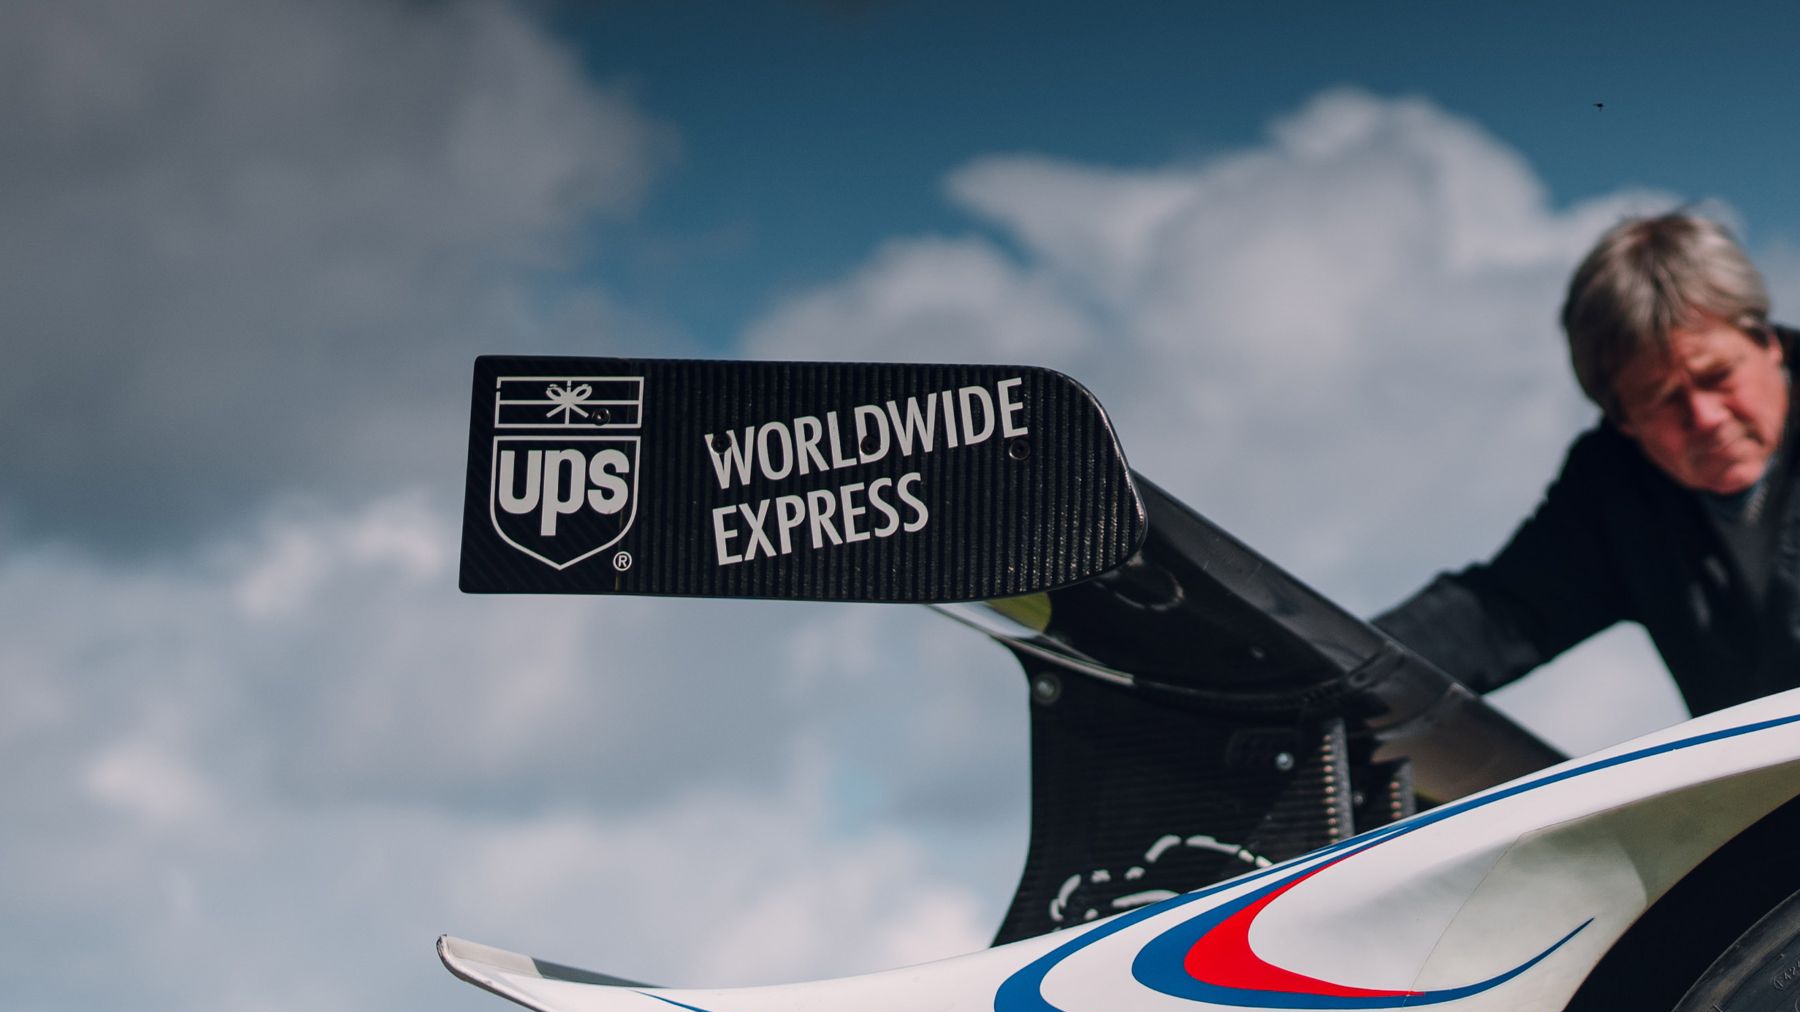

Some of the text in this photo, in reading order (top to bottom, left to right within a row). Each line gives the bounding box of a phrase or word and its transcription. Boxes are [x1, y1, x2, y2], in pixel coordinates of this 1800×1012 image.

[705, 378, 1029, 490] WORLDWIDE
[500, 449, 631, 536] ups
[712, 472, 928, 566] EXPRESS
